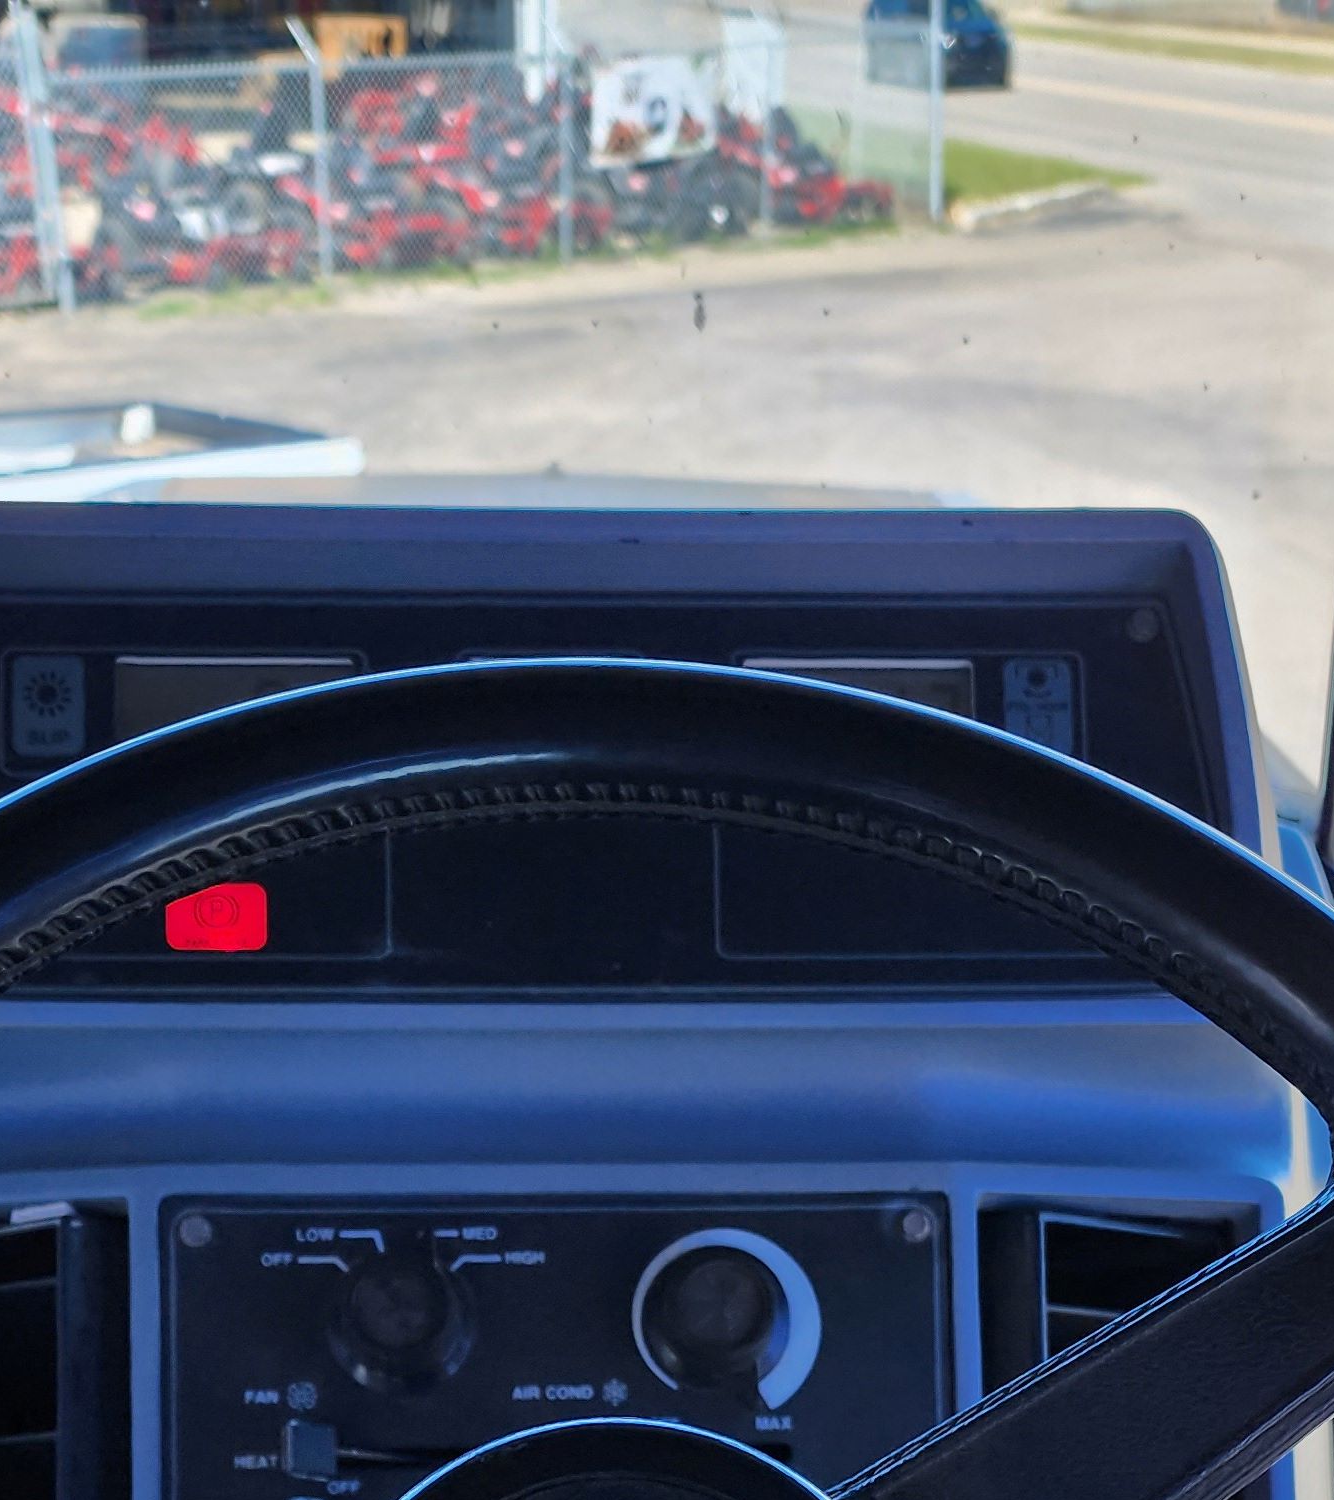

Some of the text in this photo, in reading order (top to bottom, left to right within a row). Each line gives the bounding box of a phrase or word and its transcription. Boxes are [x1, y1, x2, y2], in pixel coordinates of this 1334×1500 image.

[295, 1227, 335, 1242] LOW
[462, 1226, 498, 1241] MED
[260, 1252, 293, 1267] OFF
[504, 1250, 546, 1265] HIGH
[243, 1390, 280, 1404] FAN
[512, 1384, 595, 1401] AIR COND
[754, 1415, 793, 1431] MAX
[234, 1455, 278, 1469] HEAT
[327, 1479, 361, 1495] OFF
